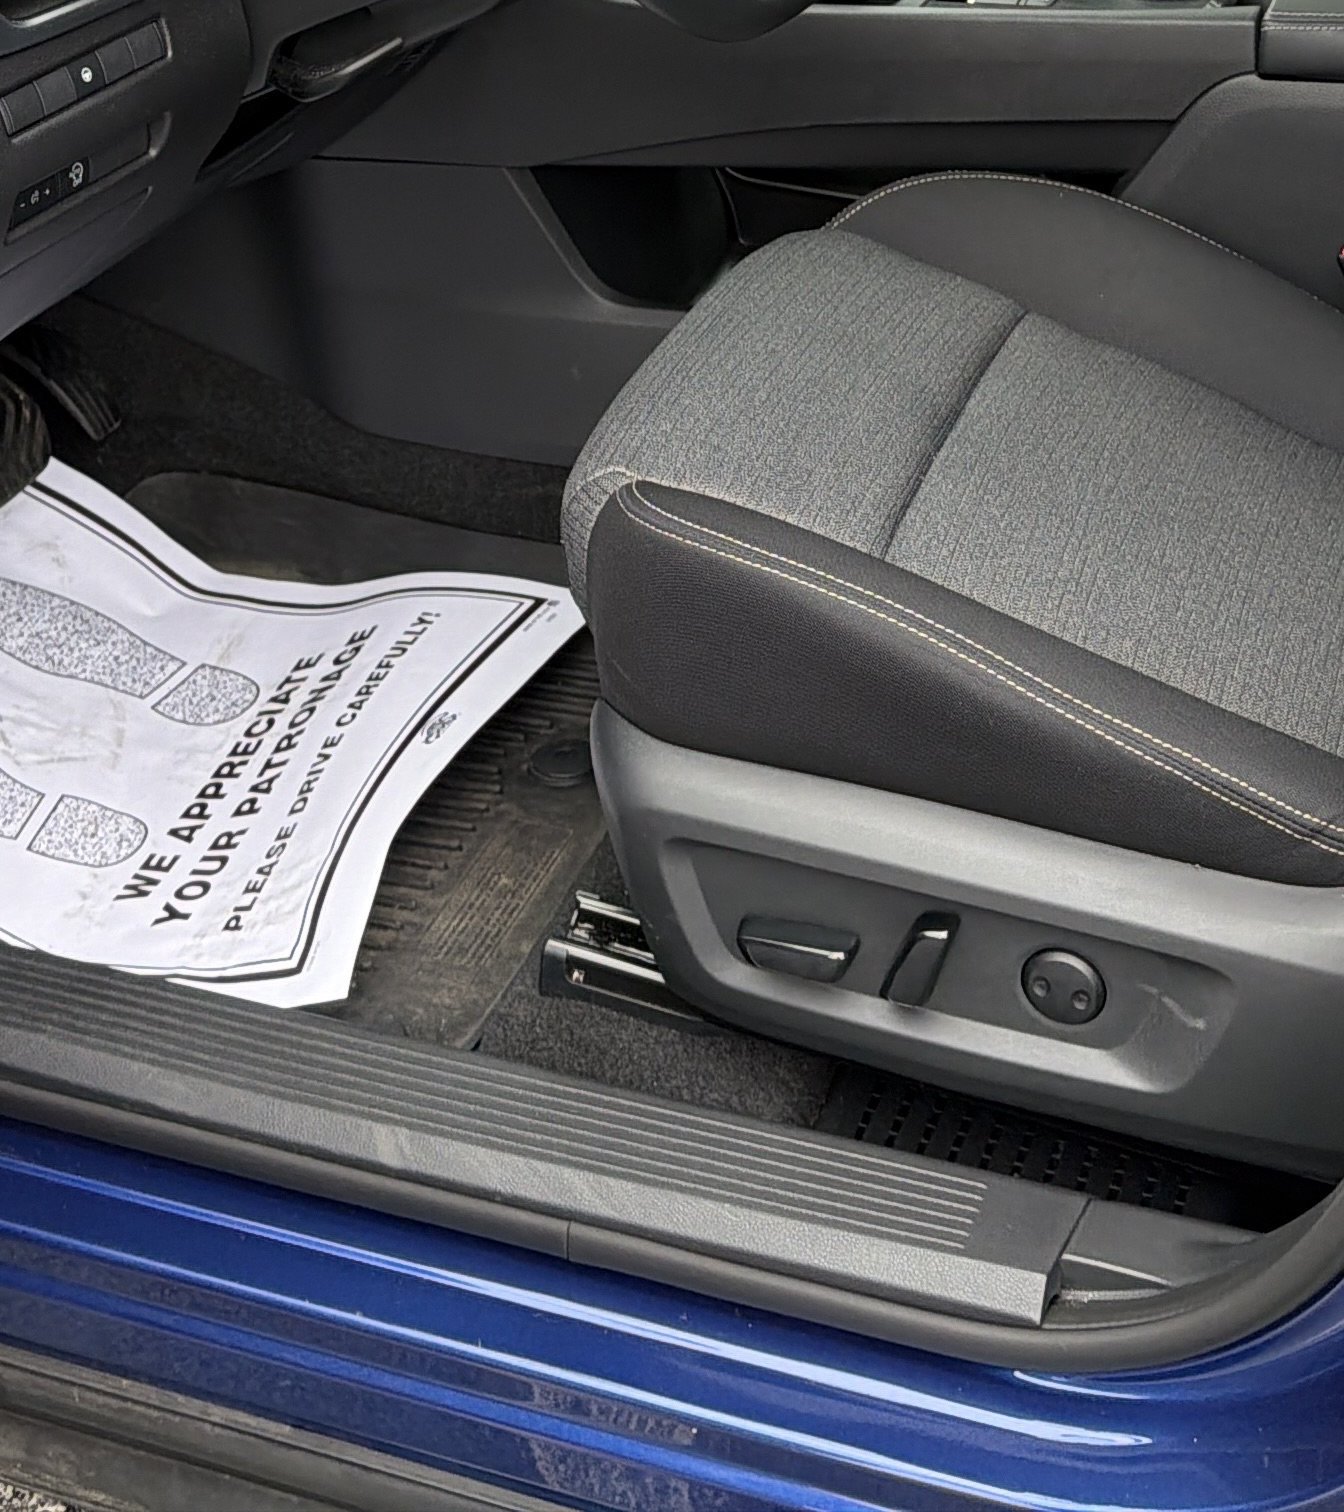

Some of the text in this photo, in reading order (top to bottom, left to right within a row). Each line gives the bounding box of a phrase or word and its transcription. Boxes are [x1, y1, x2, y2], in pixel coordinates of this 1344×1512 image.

[112, 652, 325, 901] WE APPRECIATE
[150, 624, 378, 927] YOUR PATRONAGE
[221, 821, 298, 933] PLEASE
[287, 733, 345, 817] DRIVE
[335, 610, 442, 728] CAREFULLY!
